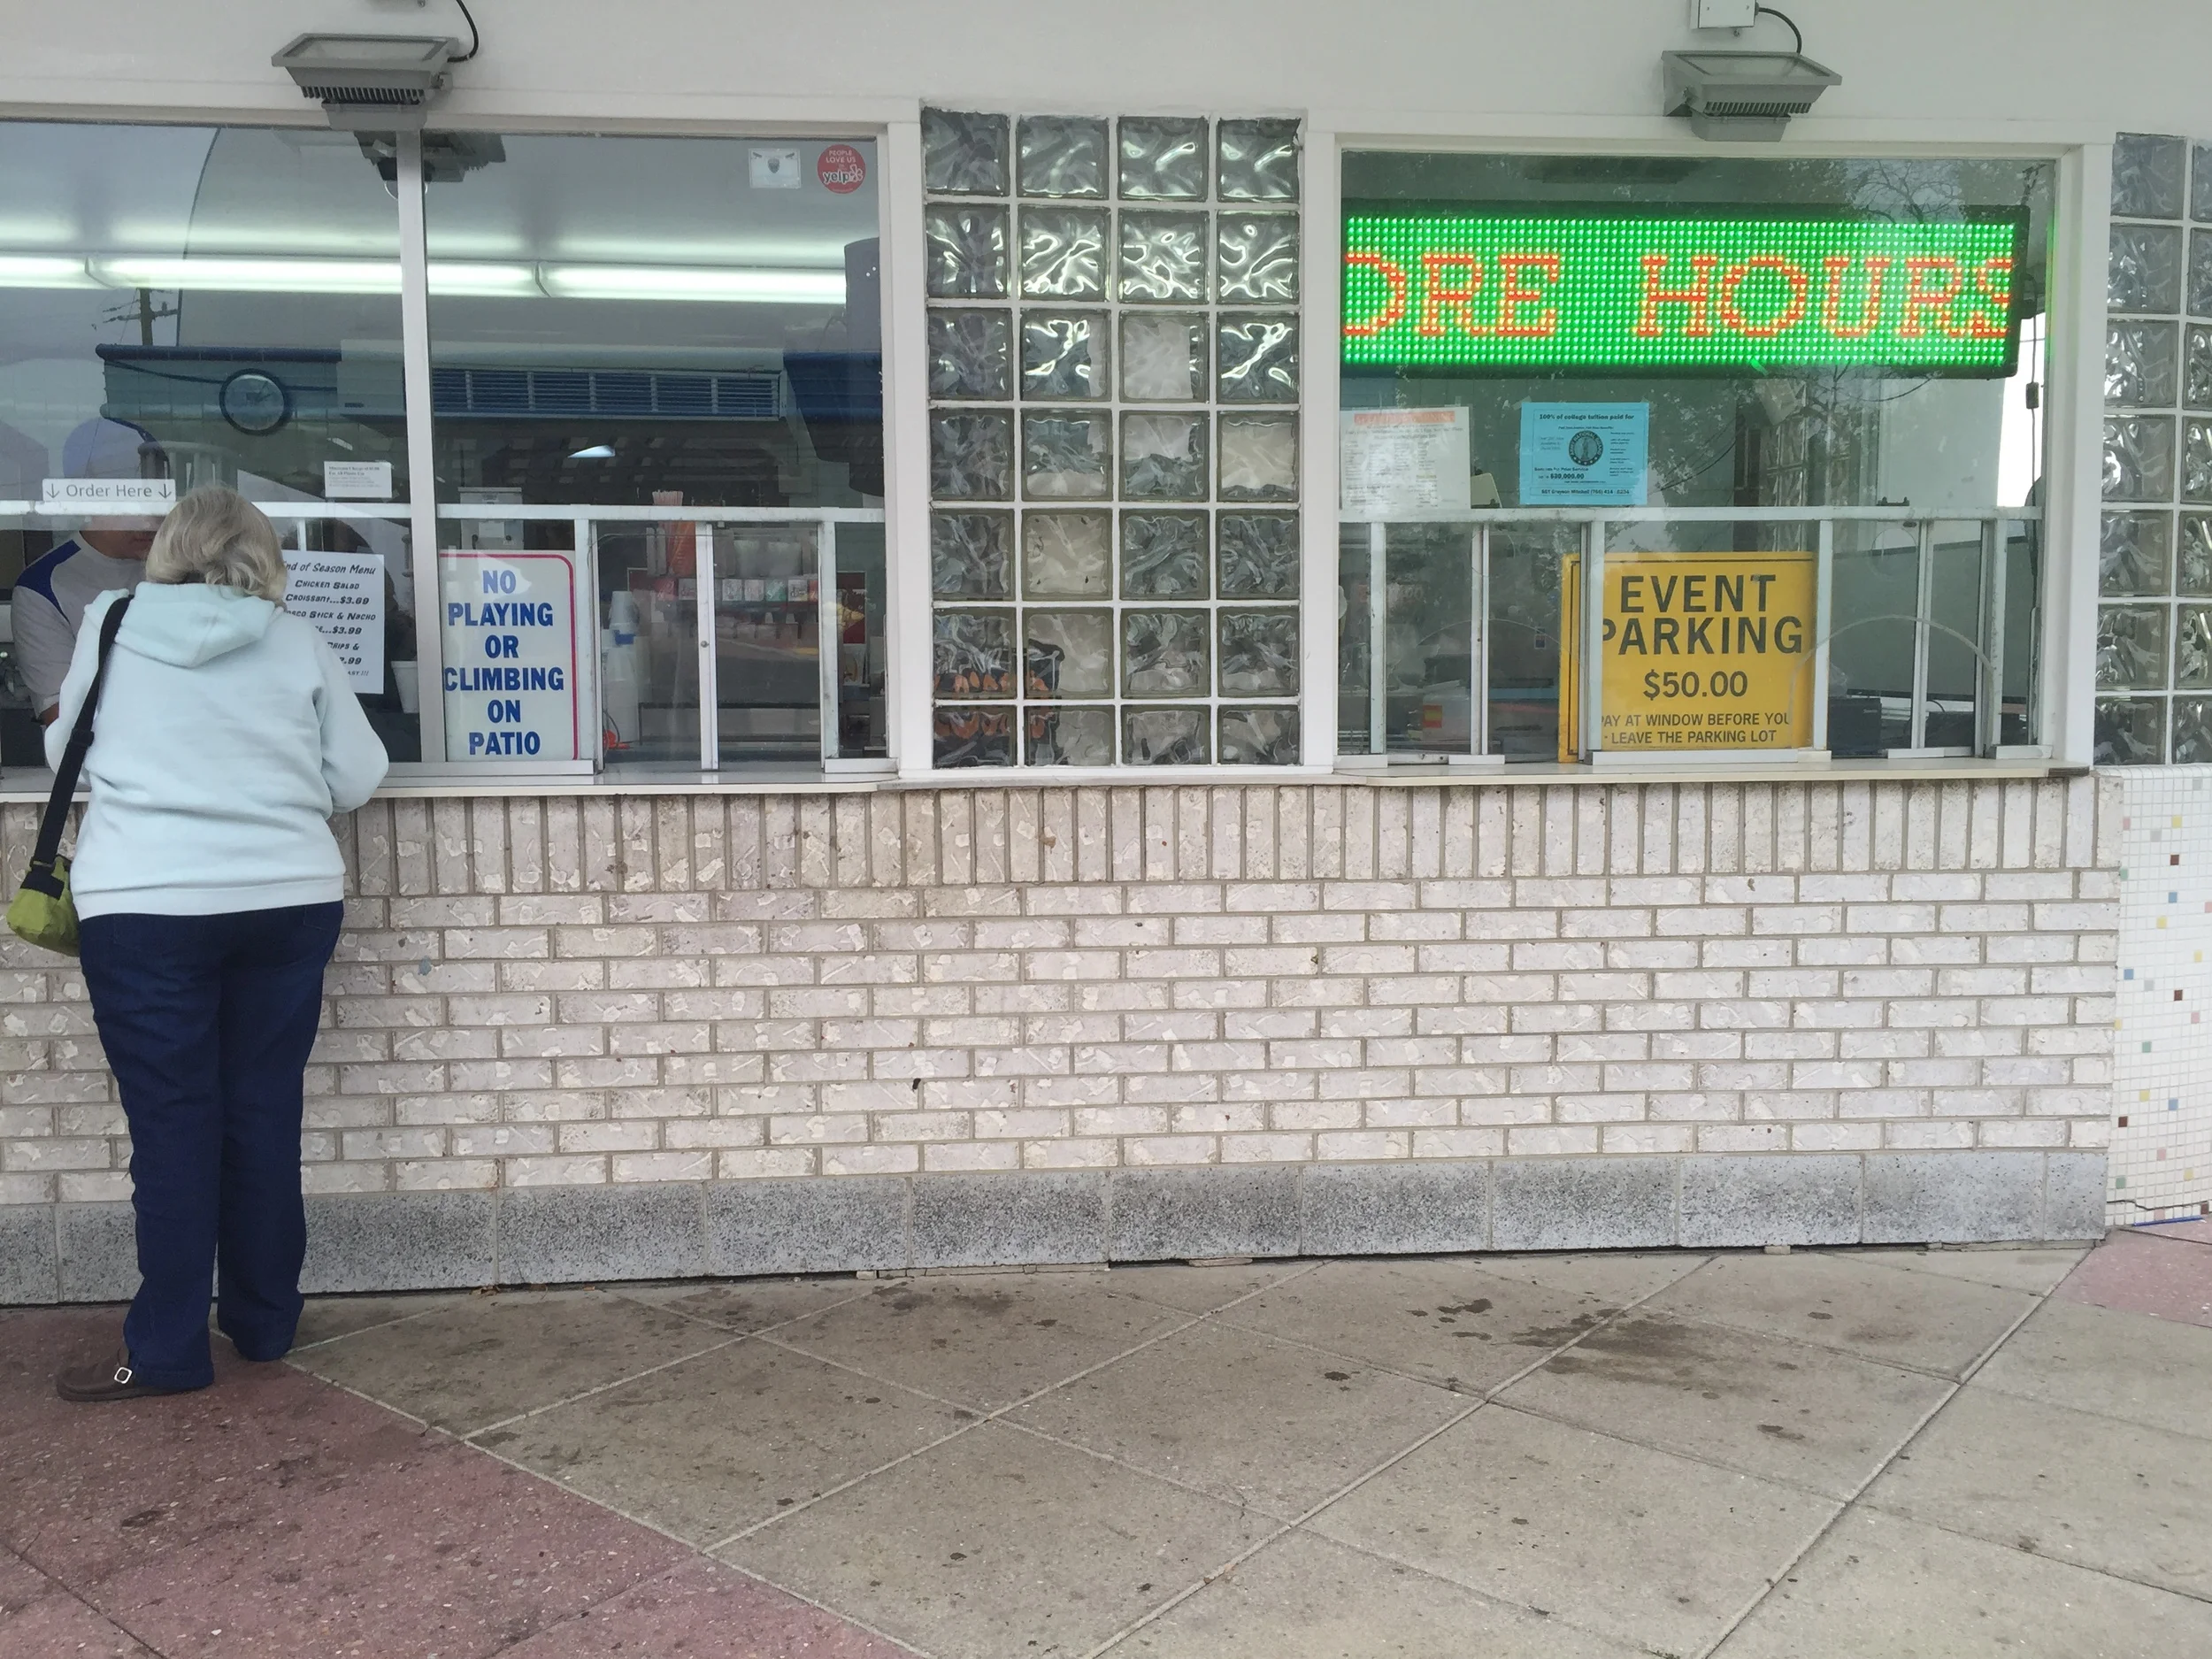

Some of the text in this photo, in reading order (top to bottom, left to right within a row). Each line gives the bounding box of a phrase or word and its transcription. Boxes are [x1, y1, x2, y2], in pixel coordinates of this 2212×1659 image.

[823, 169, 850, 185] yelp
[1632, 254, 2013, 337] HOURS
[65, 483, 152, 497] Order Here
[286, 561, 377, 575] nd of Season Menu
[482, 570, 517, 594] NO
[1620, 574, 1777, 613] EVENT
[448, 603, 554, 627] PLAYING
[485, 634, 519, 658] OR
[444, 667, 565, 691] CLIMBING
[1643, 669, 1748, 701] $50.00
[488, 700, 521, 724] ON
[1601, 715, 1621, 726] AY
[1624, 715, 1641, 726] AT
[1646, 713, 1703, 726] WINDOW
[1708, 712, 1760, 726] BEFORE
[469, 732, 541, 756] PATIO
[1611, 729, 1777, 744] LEAVE THE PARKING LOT
